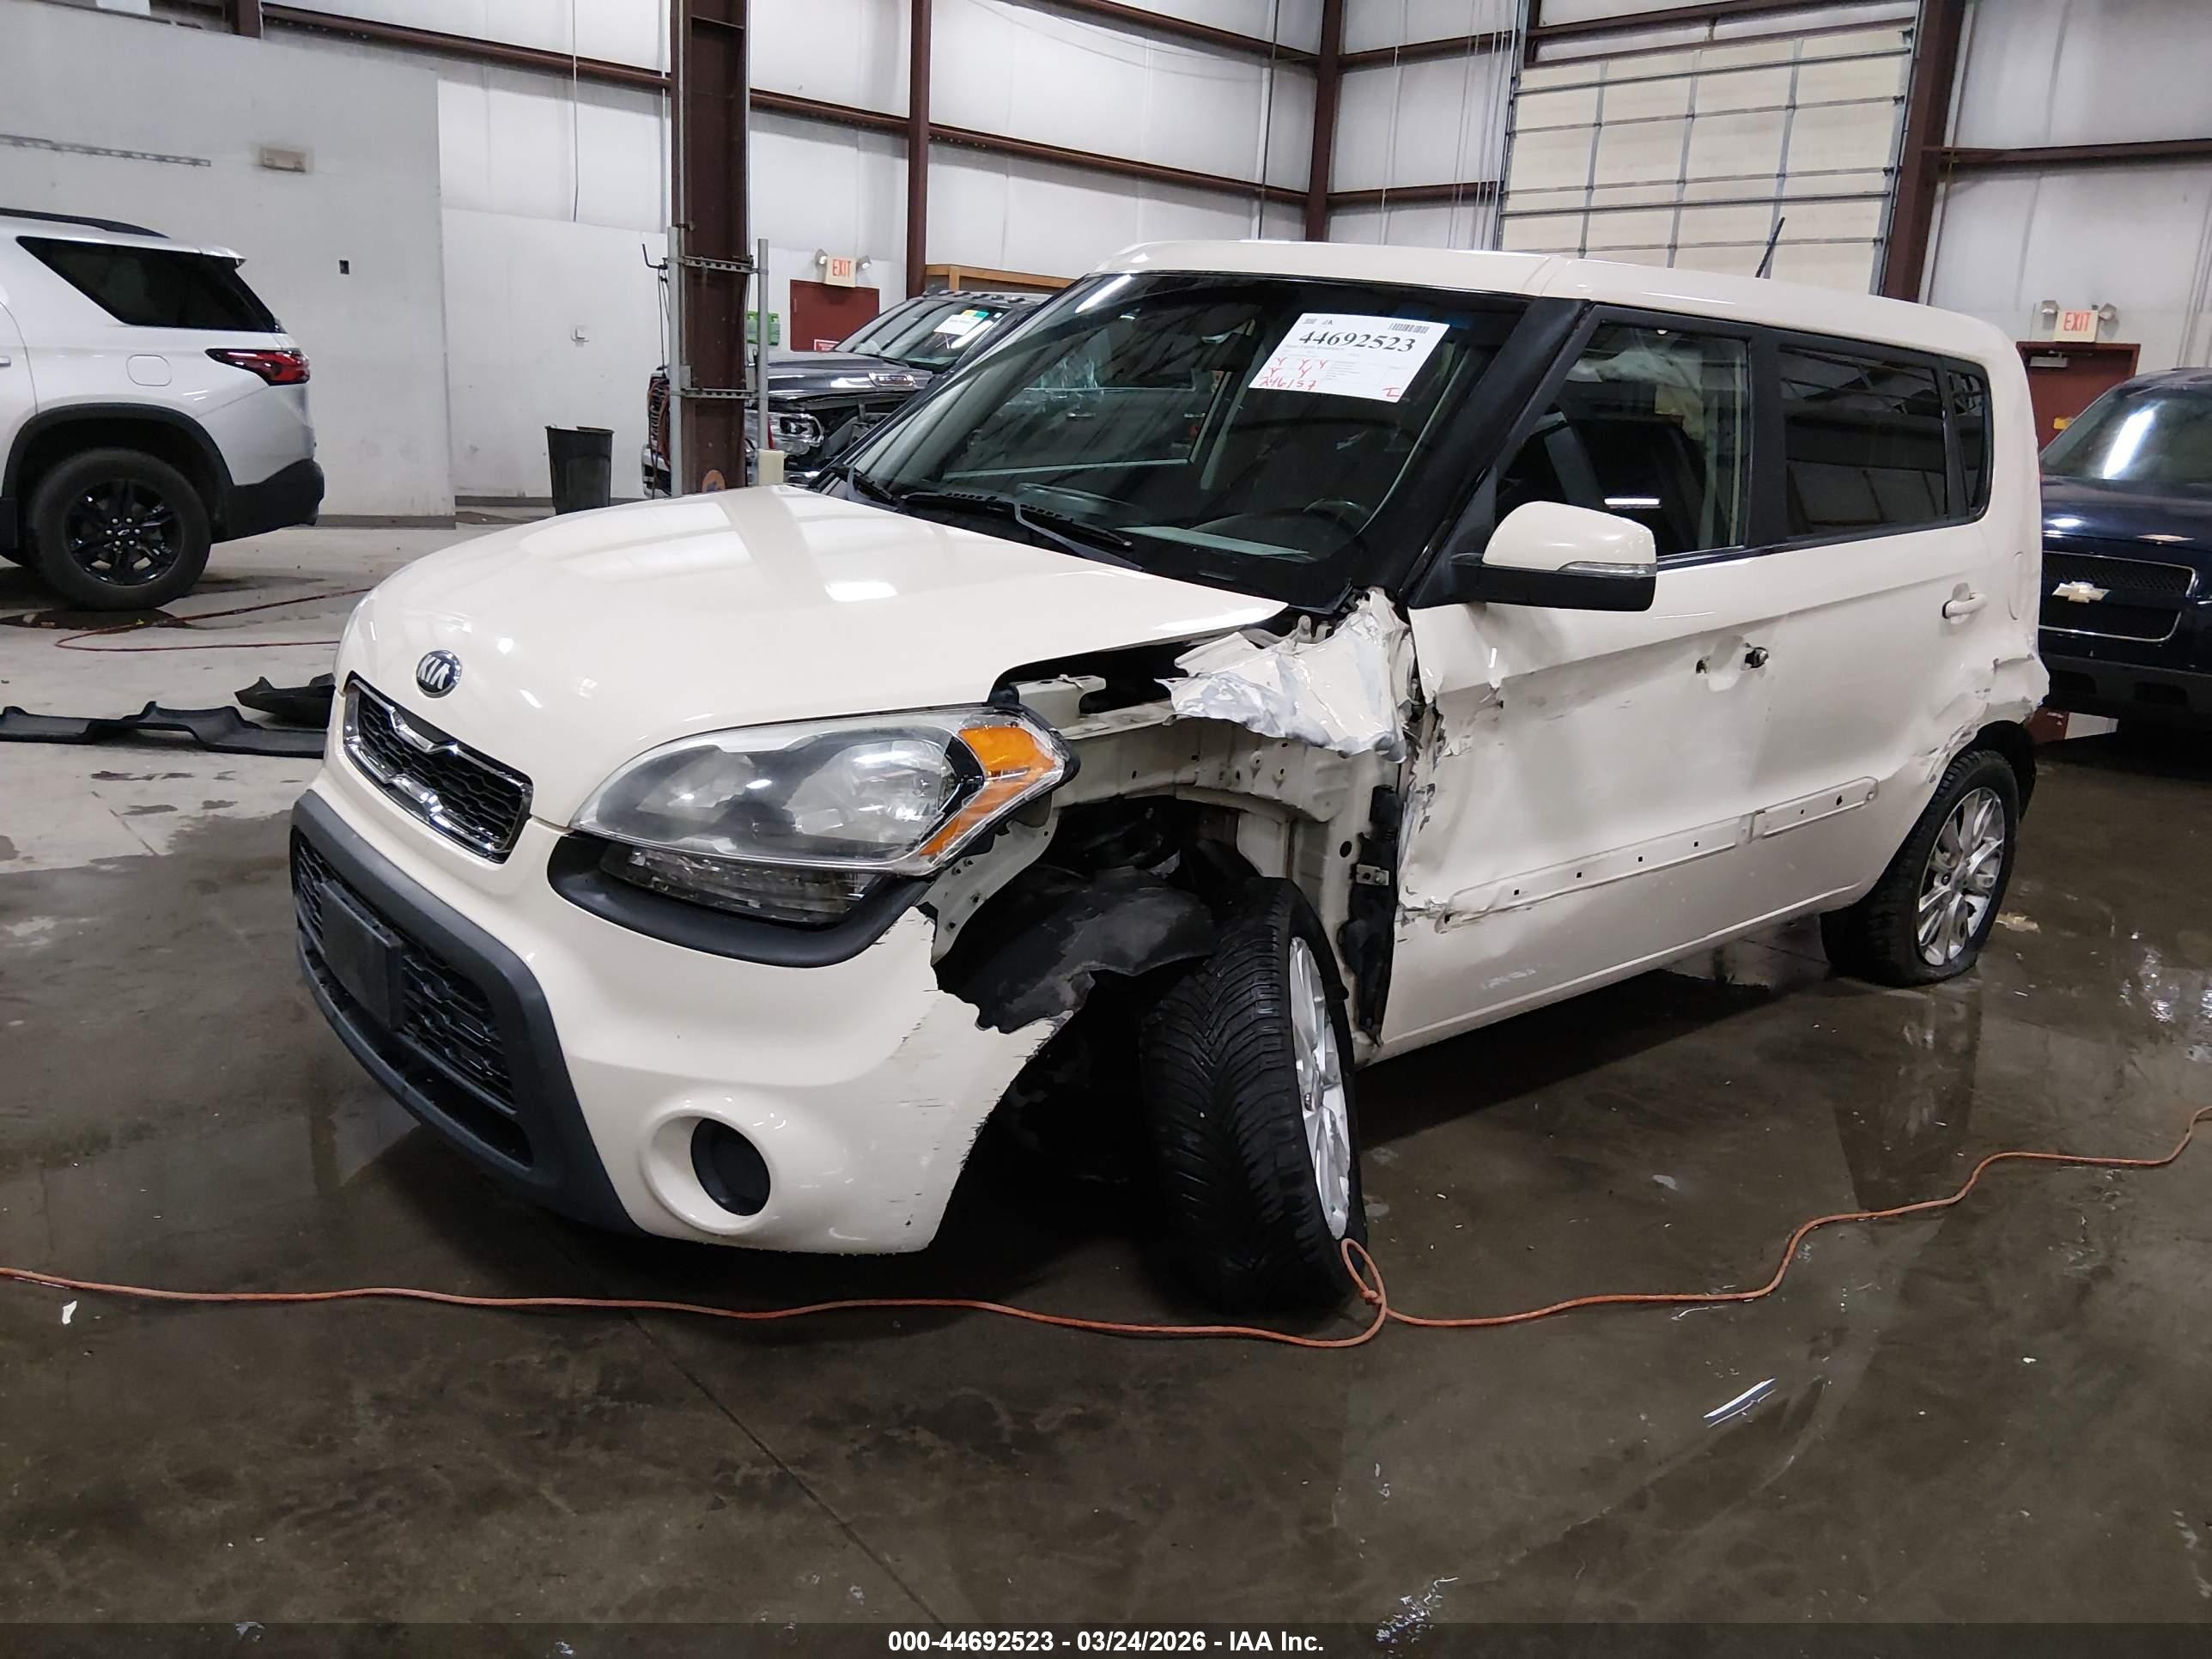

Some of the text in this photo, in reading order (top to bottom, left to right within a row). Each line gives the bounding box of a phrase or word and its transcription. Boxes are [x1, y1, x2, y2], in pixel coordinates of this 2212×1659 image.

[832, 259, 852, 278] EXIT
[2063, 312, 2091, 331] EXIT
[1298, 331, 1417, 353] 44692523
[417, 654, 451, 690] KIA
